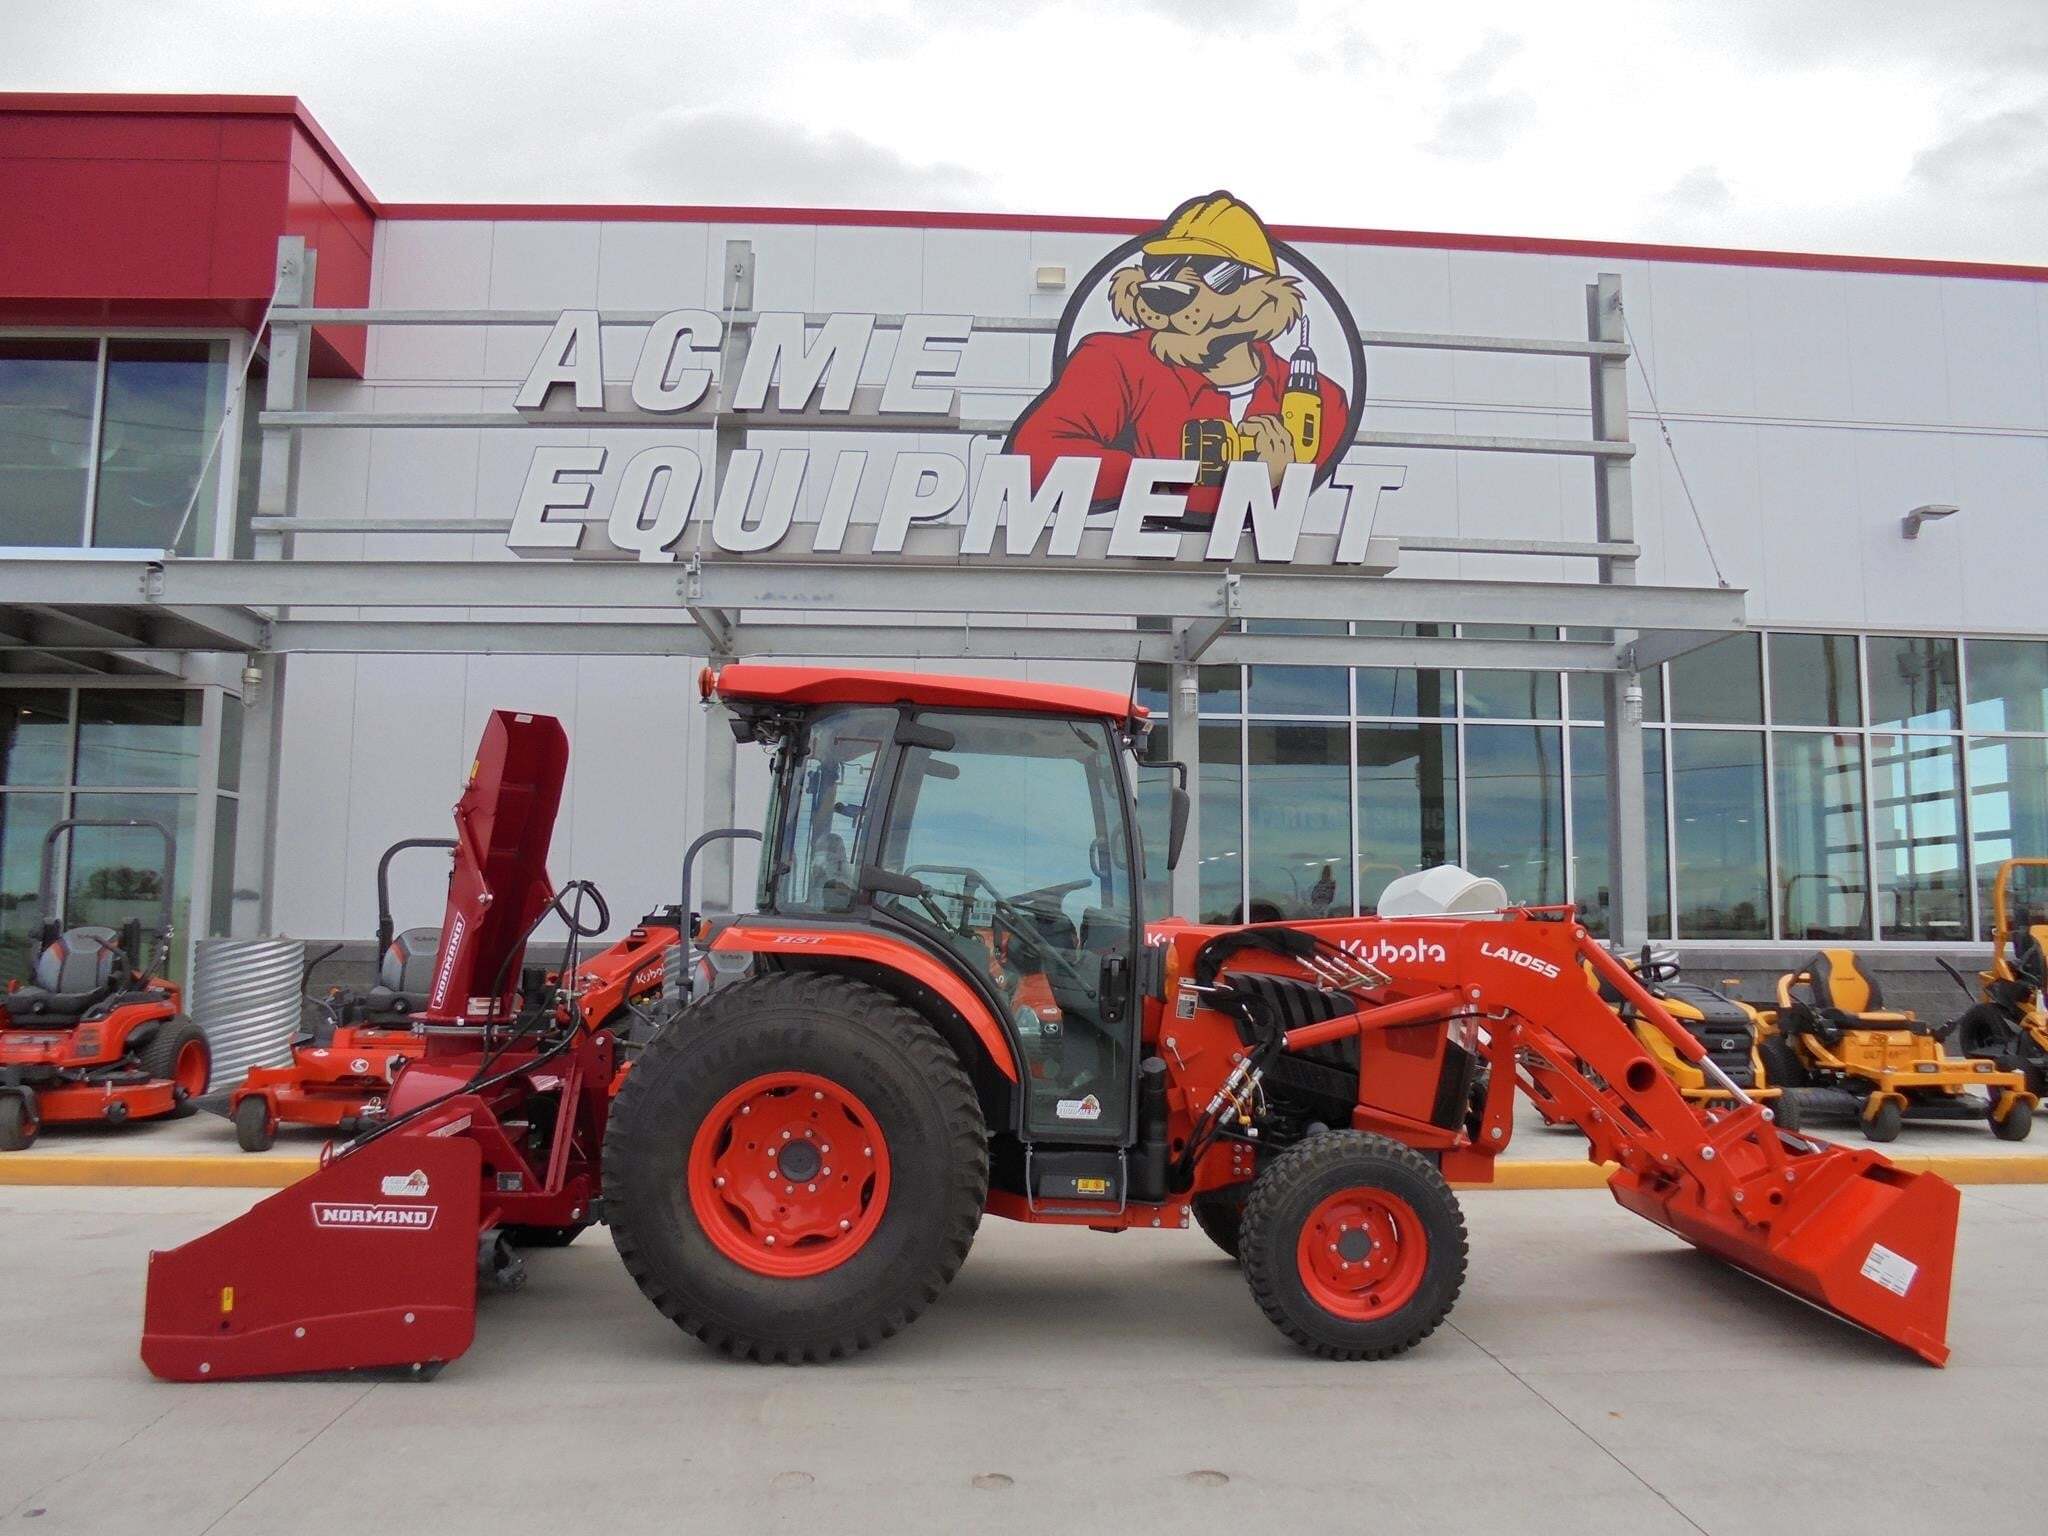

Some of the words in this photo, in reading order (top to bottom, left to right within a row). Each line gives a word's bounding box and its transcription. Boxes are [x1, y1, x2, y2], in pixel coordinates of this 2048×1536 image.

[513, 309, 975, 415] ACME
[505, 446, 1407, 564] EQUIPMENT
[773, 936, 826, 945] HST
[1340, 938, 1446, 963] Kubota
[435, 920, 464, 1003] NORMAND
[1481, 942, 1561, 979] LA1055
[323, 1209, 428, 1224] NORMAND
